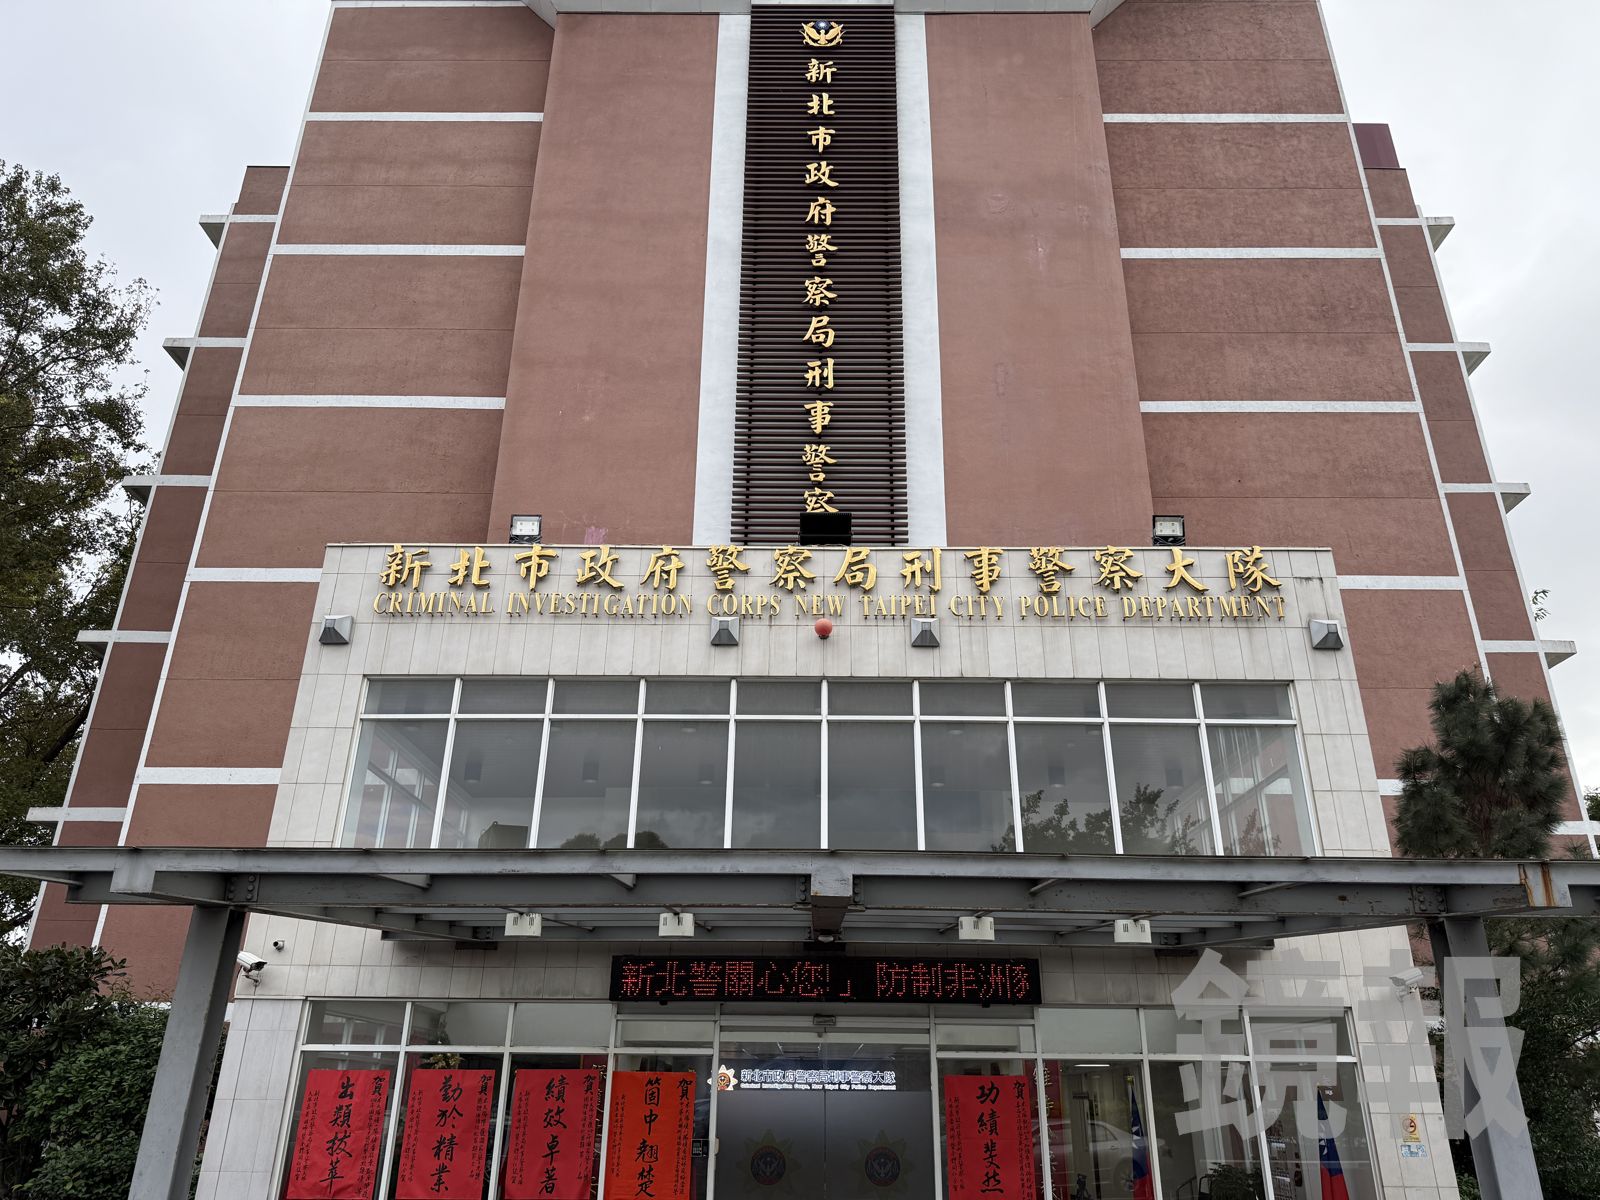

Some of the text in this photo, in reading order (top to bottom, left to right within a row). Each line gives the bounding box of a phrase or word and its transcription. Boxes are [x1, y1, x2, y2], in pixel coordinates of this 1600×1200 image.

[378, 543, 1283, 594] 新北市政府警察局刑事警察大隊
[372, 591, 1287, 621] CRIMINAL INVESTIGATION CORPS NEW TAIPEI CITY POLICE DEPARTMENT
[372, 1075, 386, 1097] 賀
[478, 1074, 493, 1097] 賀
[583, 1074, 597, 1096] 賀
[676, 1078, 694, 1101] 賀
[1013, 1080, 1026, 1101] 賀
[430, 1074, 464, 1194] 勤於精業
[538, 1074, 570, 1195] 績效卓著
[634, 1076, 662, 1198] 箇中翹楚
[976, 1081, 1005, 1195] 功績斐然
